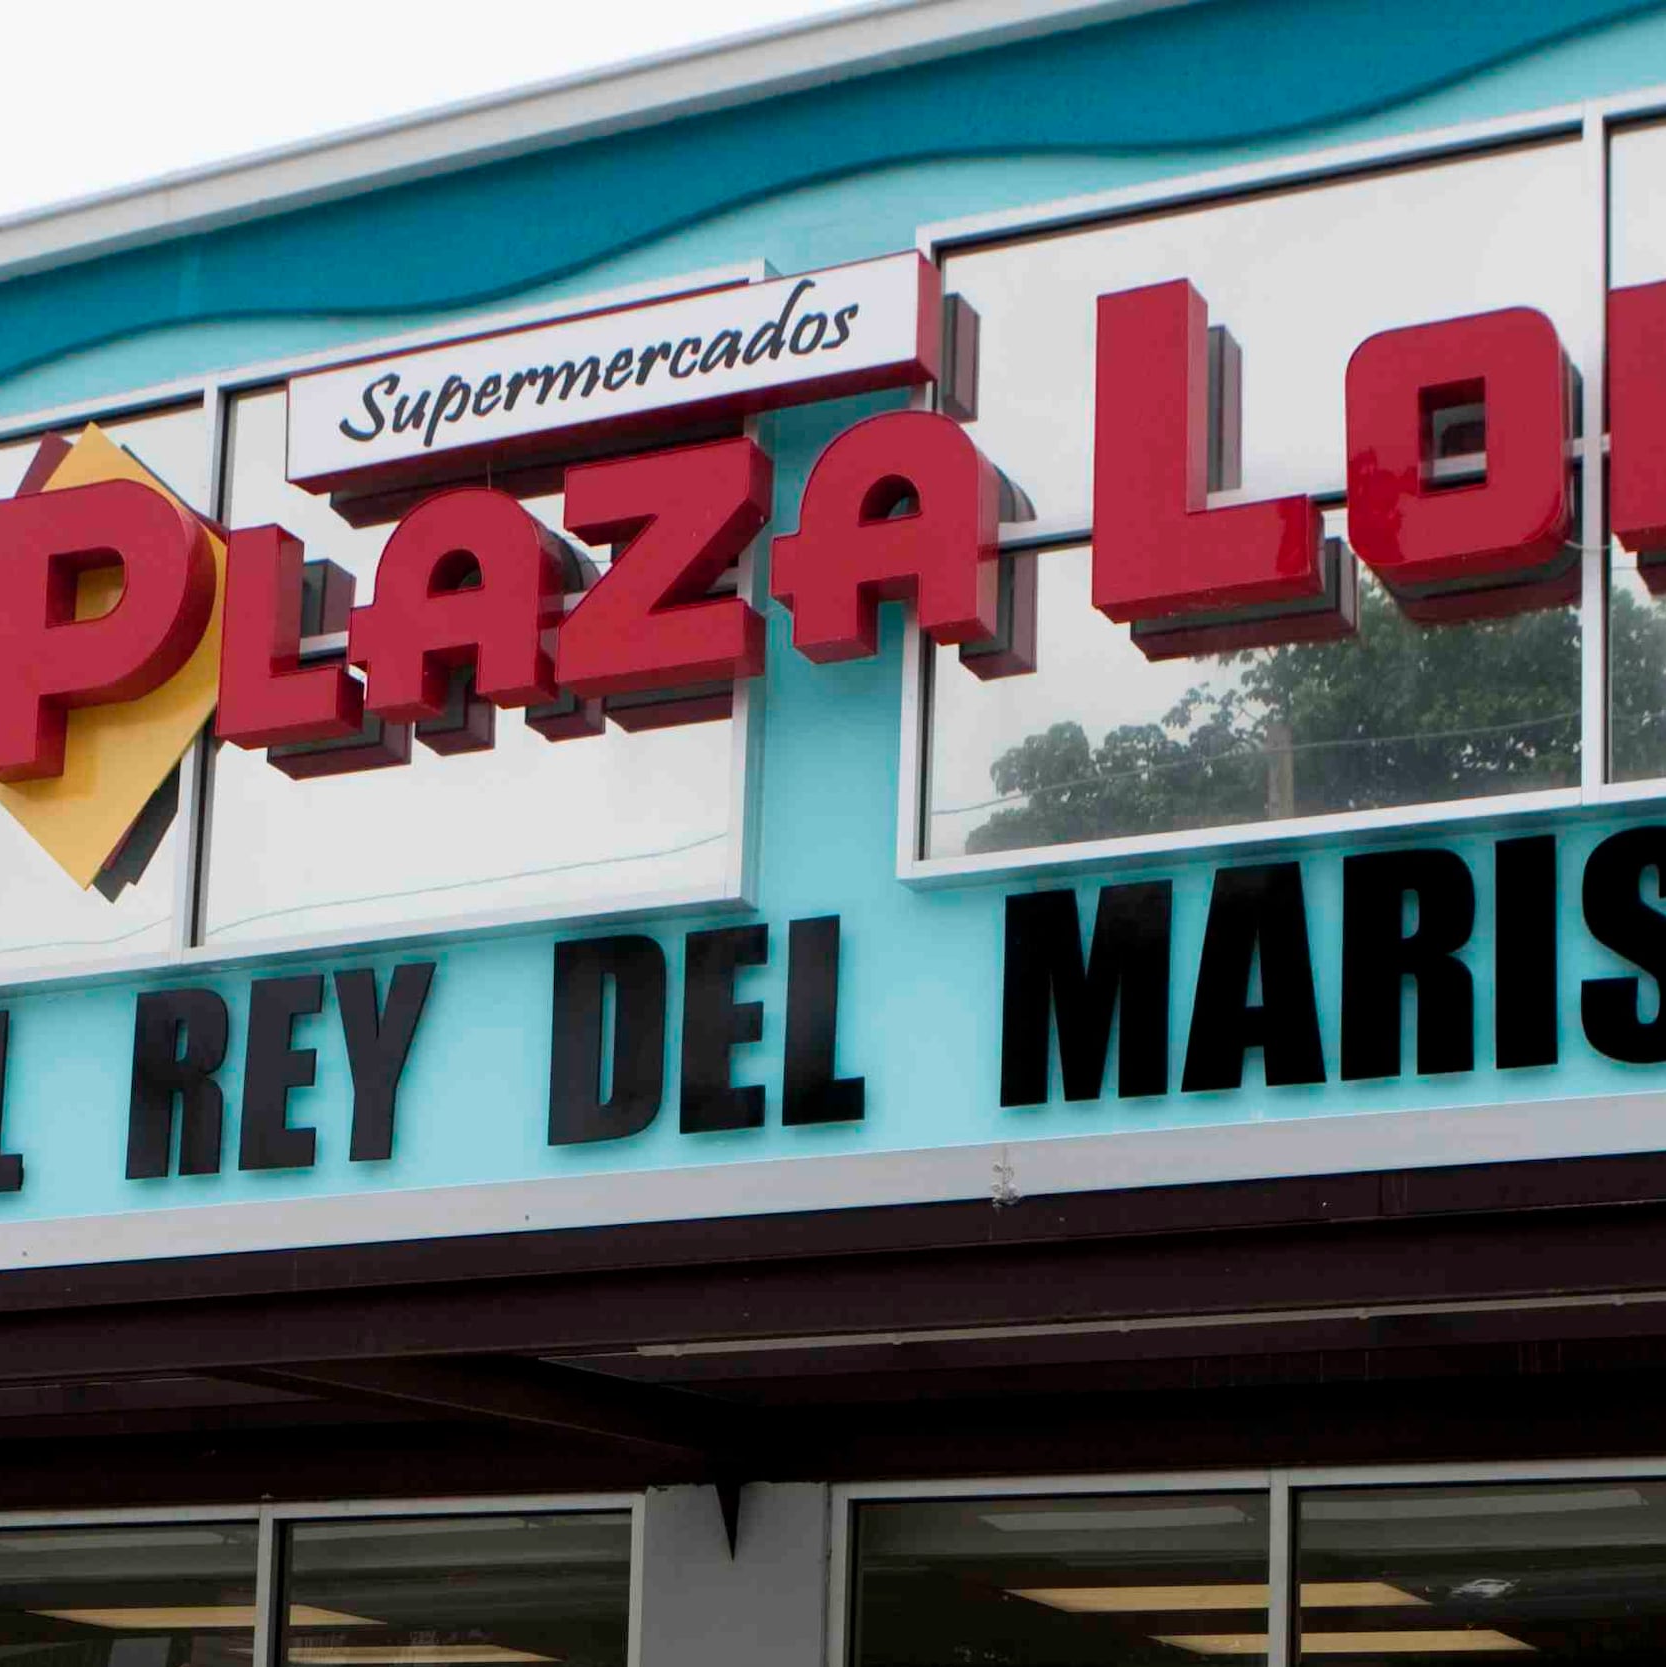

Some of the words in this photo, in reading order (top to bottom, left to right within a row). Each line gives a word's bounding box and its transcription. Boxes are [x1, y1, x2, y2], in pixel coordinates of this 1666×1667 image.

[339, 278, 860, 447] Supermercados
[124, 962, 437, 1181] REY
[548, 914, 867, 1148] DEL
